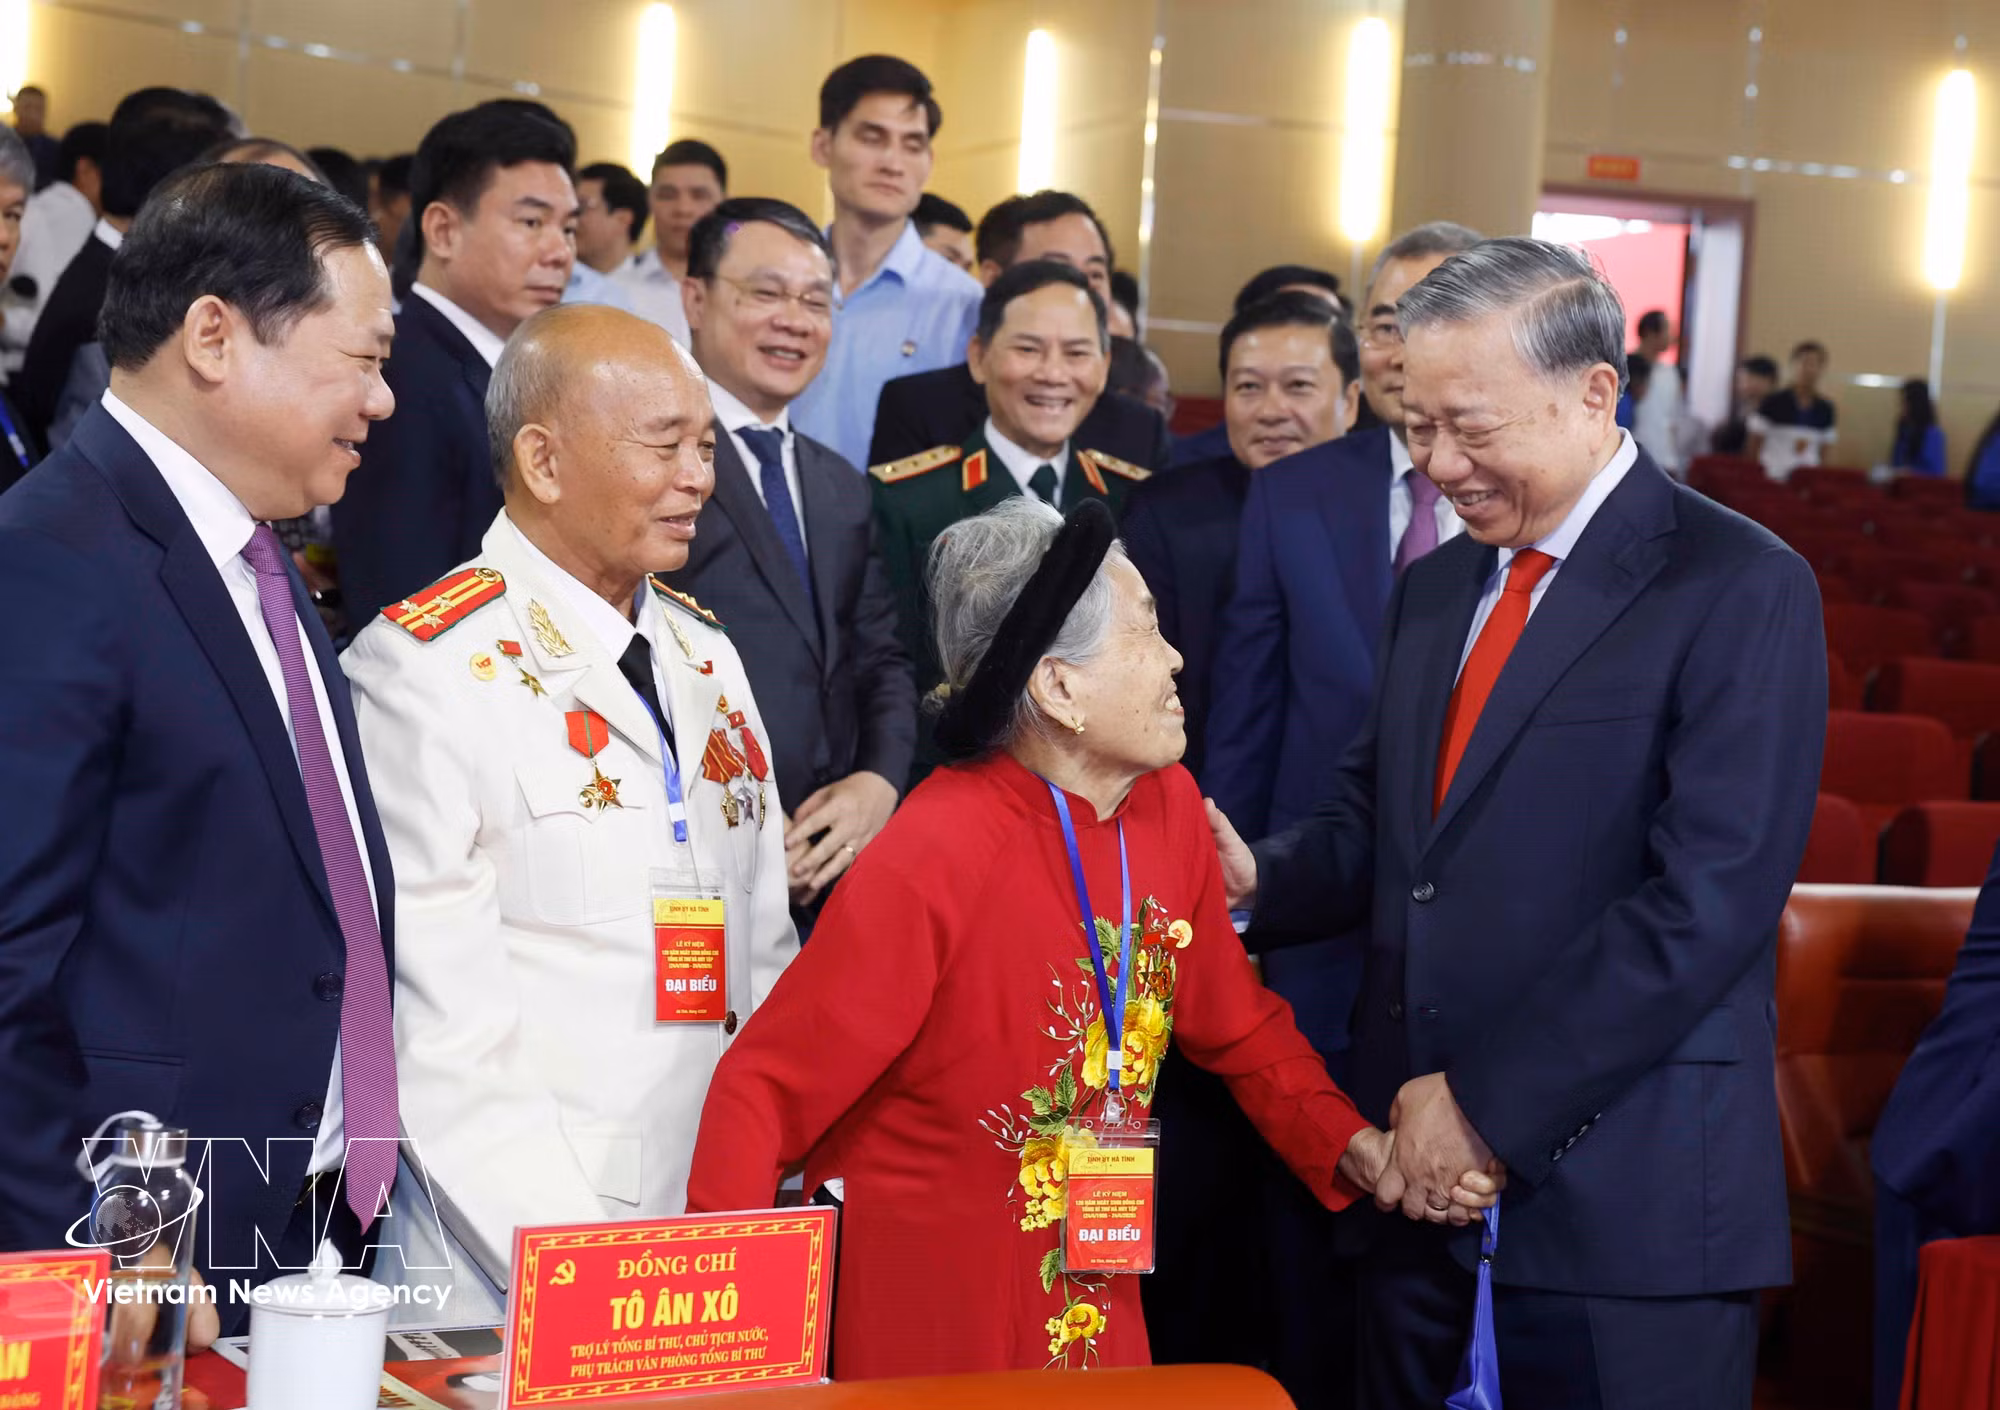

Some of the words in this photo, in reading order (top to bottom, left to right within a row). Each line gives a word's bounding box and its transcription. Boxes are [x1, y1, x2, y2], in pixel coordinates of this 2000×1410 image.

[665, 978, 686, 994] ĐẠI
[690, 974, 717, 992] BIỂU
[1078, 1228, 1104, 1244] ĐẠI
[1107, 1223, 1141, 1241] BIỂU
[617, 1248, 688, 1279] ĐỒNG
[694, 1246, 737, 1273] CHÍ
[609, 1289, 646, 1331] TÔ
[652, 1287, 694, 1327] ÂN
[700, 1282, 739, 1323] XÔ
[570, 1342, 596, 1360] TRỢ
[595, 1339, 610, 1356] LÝ
[612, 1334, 643, 1355] TỔNG
[644, 1337, 657, 1351] BÍ
[659, 1335, 684, 1350] THƯ,
[685, 1329, 709, 1348] CHỦ
[710, 1331, 735, 1347] TỊCH
[737, 1326, 769, 1342] NƯỚC,
[570, 1363, 596, 1378] PHỤ
[597, 1358, 634, 1375] TRÁCH
[636, 1356, 659, 1372] VĂN
[660, 1352, 698, 1369] PHÒNG
[699, 1348, 729, 1366] TỔNG
[731, 1349, 743, 1362] BÍ
[744, 1346, 767, 1360] THƯ
